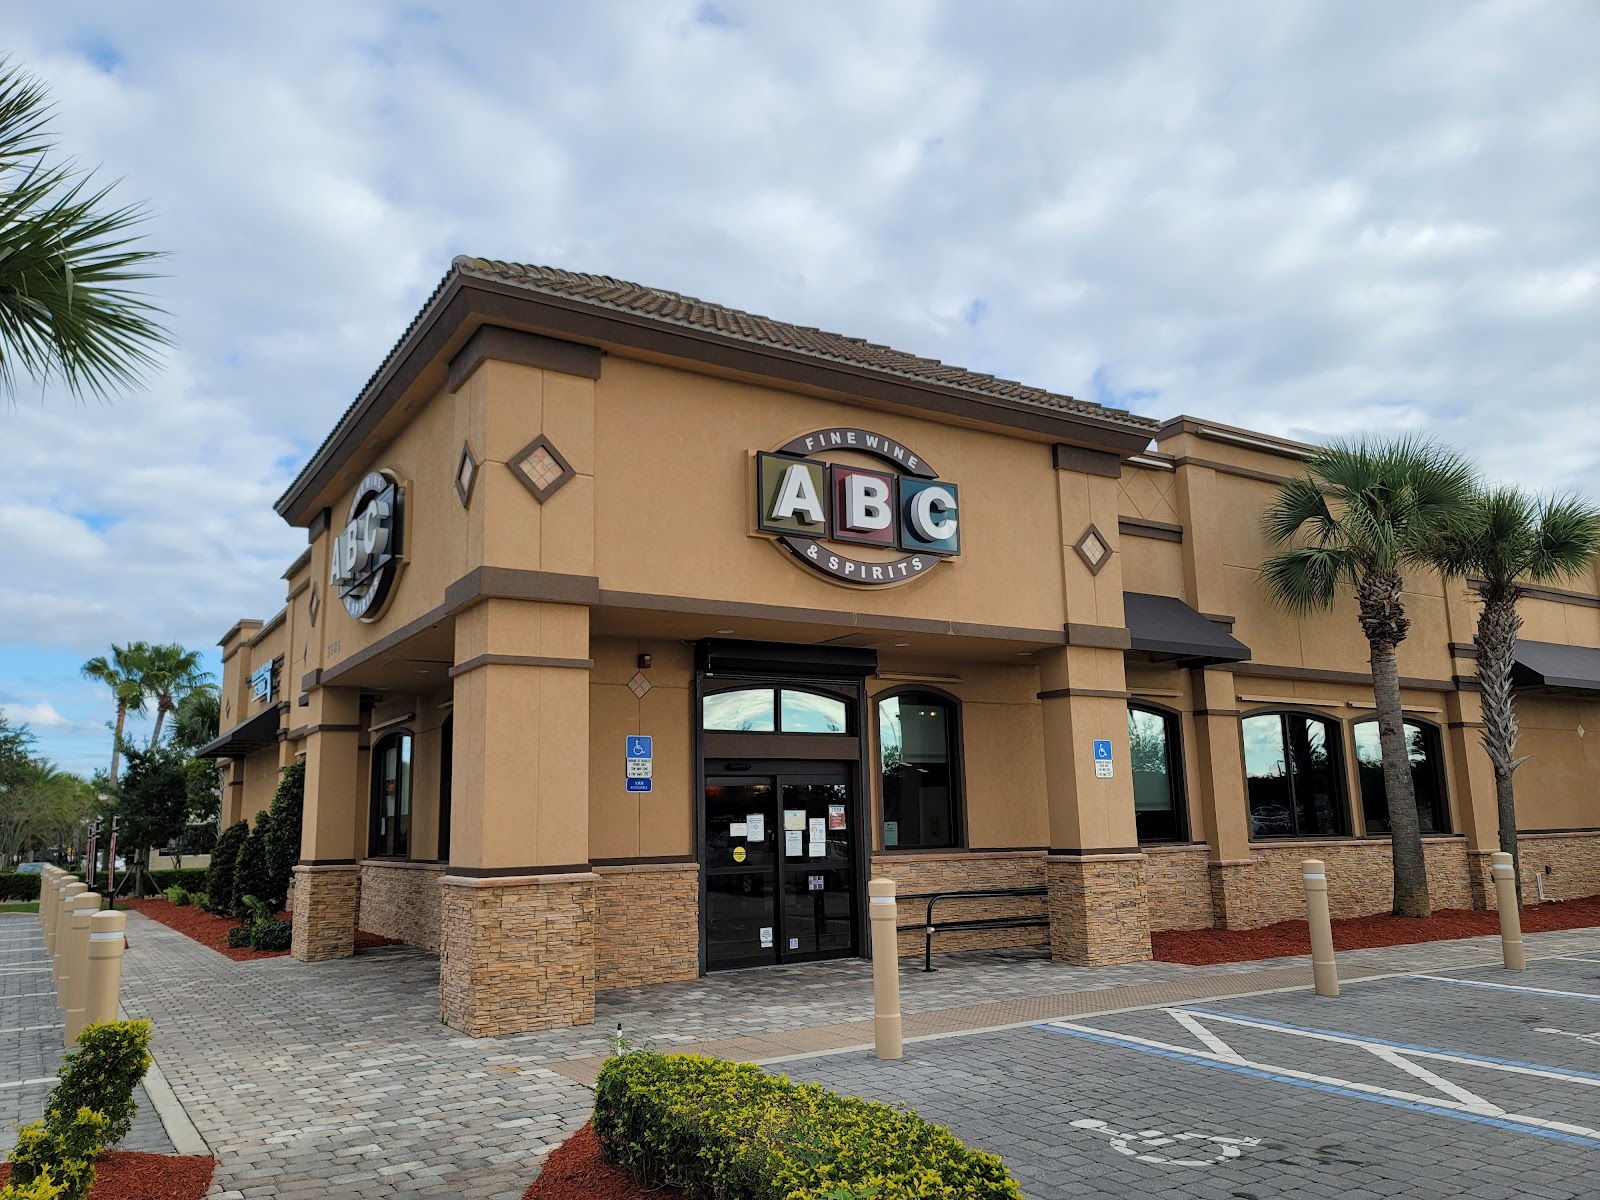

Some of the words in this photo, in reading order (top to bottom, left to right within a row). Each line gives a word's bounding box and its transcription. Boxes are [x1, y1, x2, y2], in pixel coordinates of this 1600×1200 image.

[805, 431, 857, 451] FINE
[865, 434, 918, 470] WINE
[771, 463, 958, 542] ABC
[330, 499, 390, 587] ABC
[806, 544, 818, 560] &
[828, 556, 923, 580] SPIRITS
